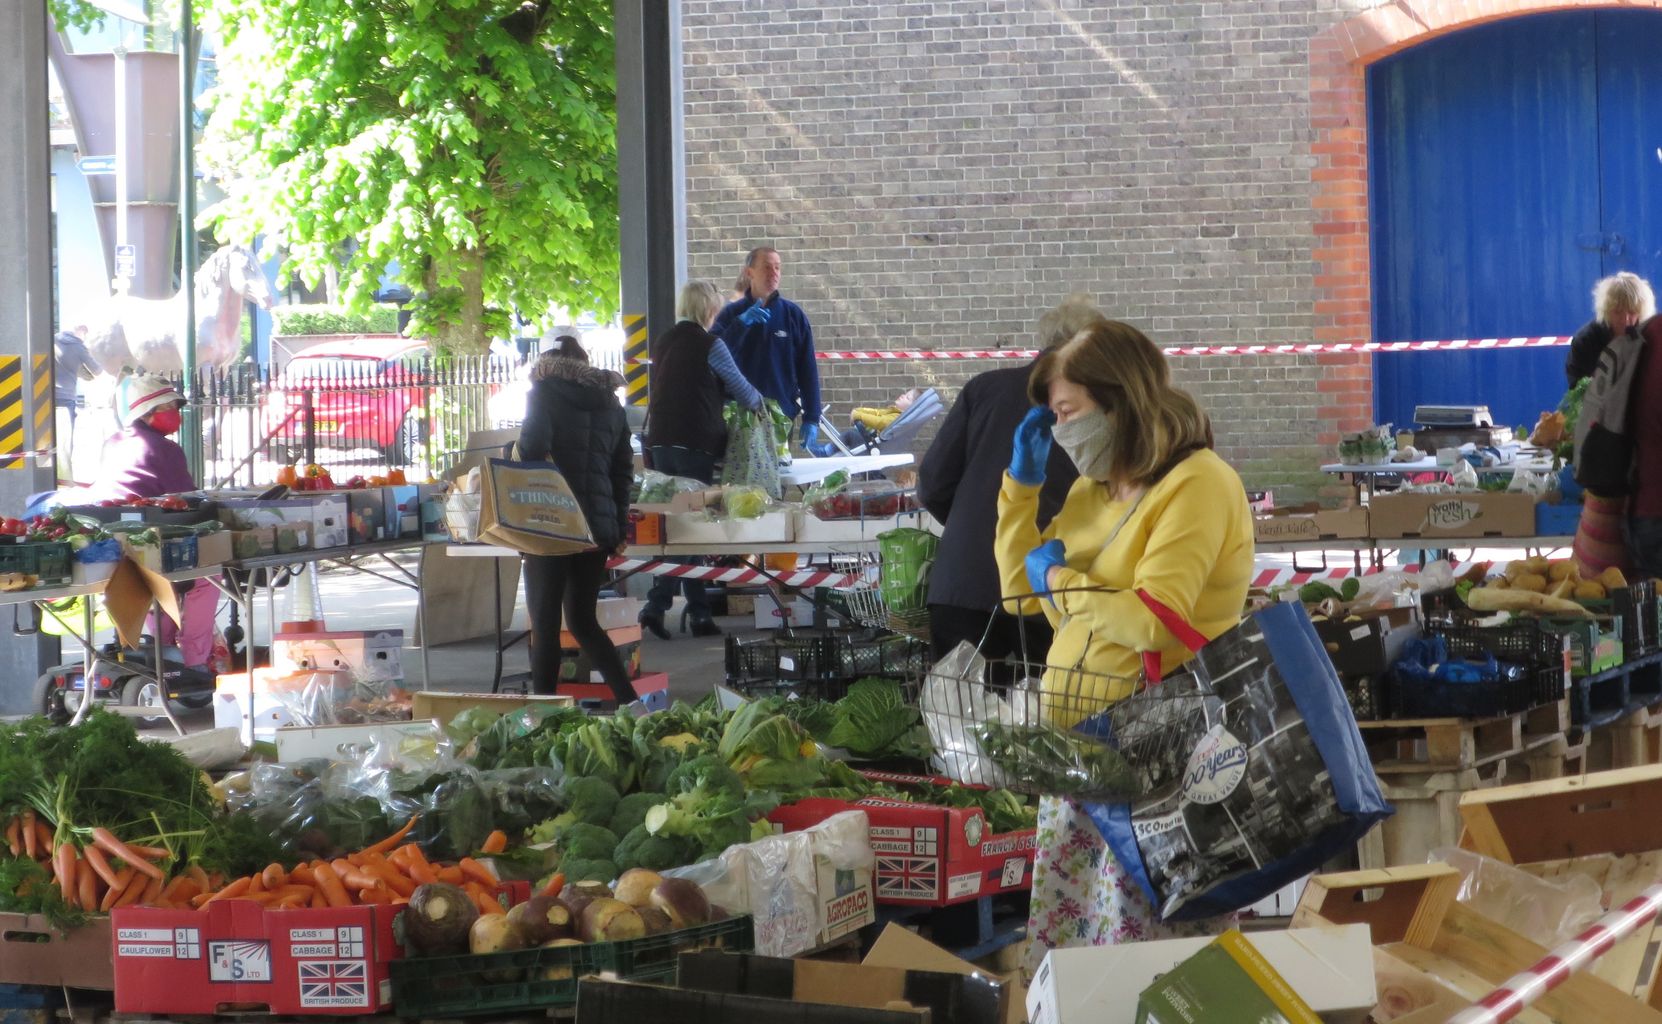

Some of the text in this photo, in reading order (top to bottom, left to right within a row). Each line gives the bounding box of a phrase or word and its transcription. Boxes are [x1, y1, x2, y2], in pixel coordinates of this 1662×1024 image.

[517, 490, 570, 508] THINGS
[871, 828, 895, 836] CLASS
[871, 842, 909, 851] CABBAGE
[915, 844, 924, 853] 12
[879, 888, 935, 898] BRITISH PRODUCE
[826, 891, 868, 924] AGROPACO
[119, 931, 143, 939] CLASS
[178, 932, 184, 940] 9
[292, 930, 317, 938] CLASS
[340, 930, 347, 939] 9
[119, 946, 171, 955] CAULIFLOWER
[177, 946, 187, 955] 12
[213, 944, 225, 964] F
[292, 946, 333, 955] CABBAGE
[340, 946, 350, 955] 12
[222, 960, 228, 968] &
[231, 959, 260, 979] S LTD
